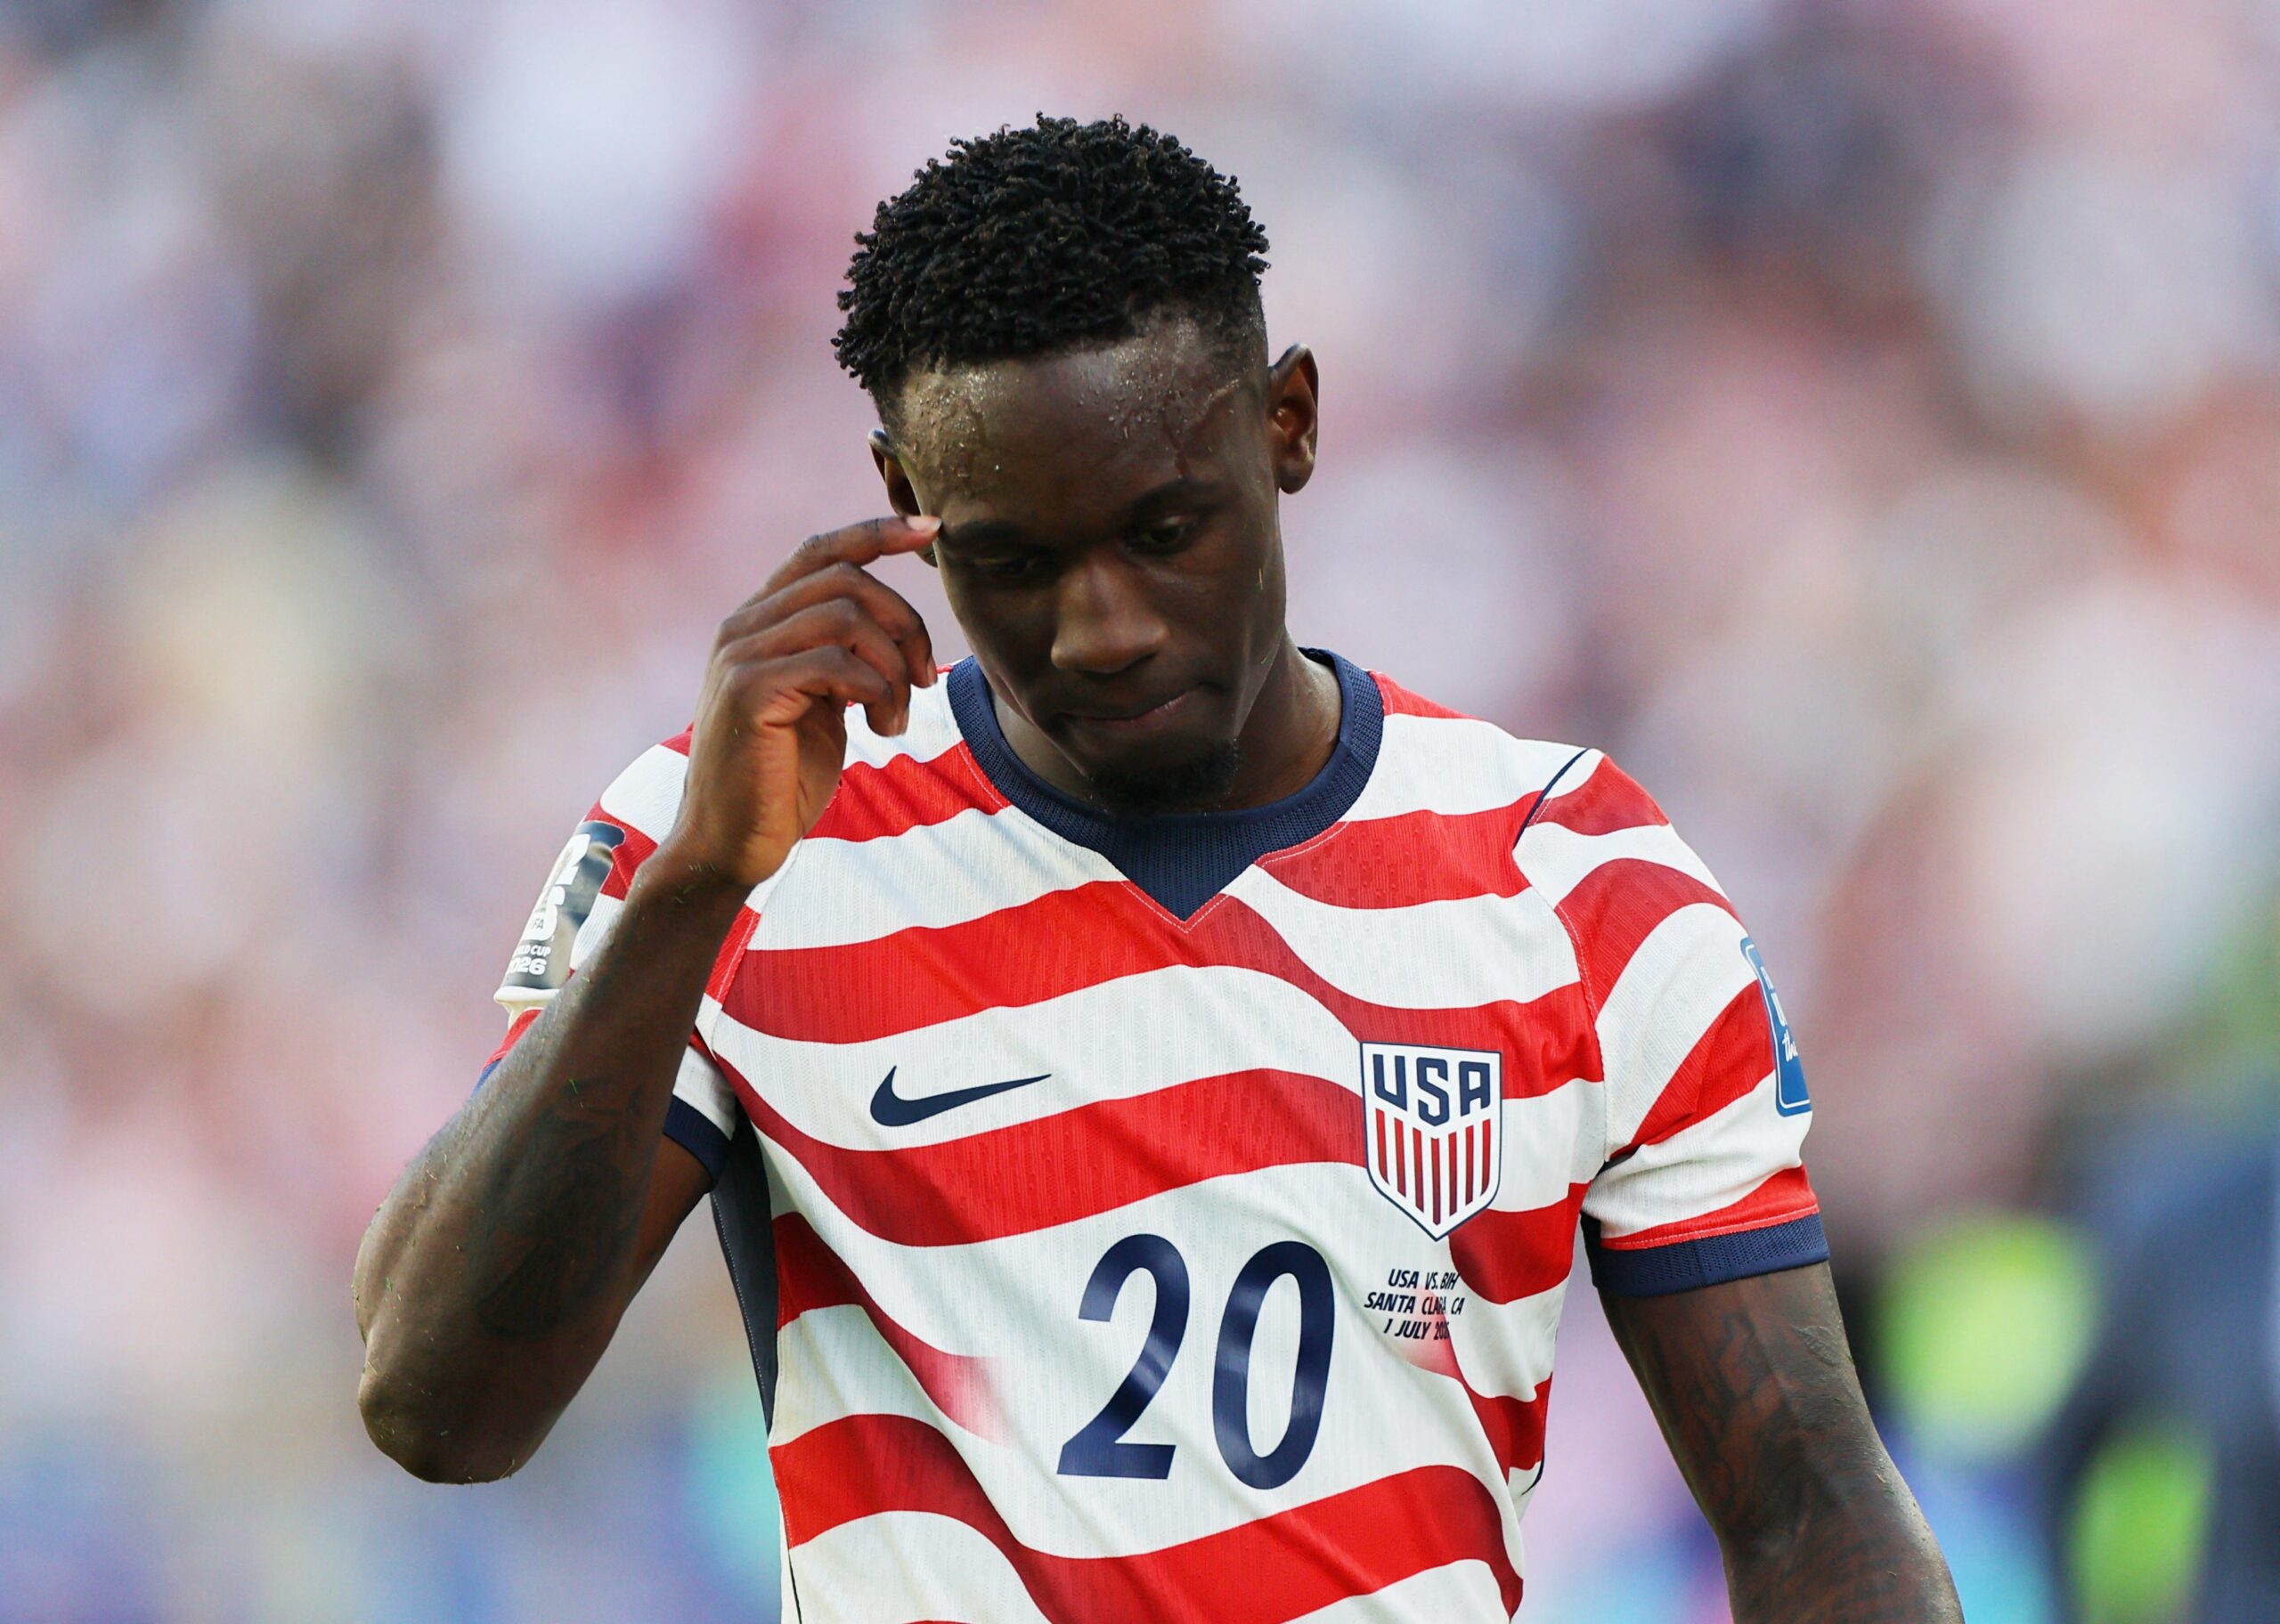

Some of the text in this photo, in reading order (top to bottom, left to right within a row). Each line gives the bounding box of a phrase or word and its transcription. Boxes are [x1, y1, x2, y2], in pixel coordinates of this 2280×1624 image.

[530, 945, 551, 957] CUP
[505, 956, 548, 976] 026
[1372, 1053, 1491, 1126] USA
[1388, 1269, 1461, 1290] USA VS. BIH
[1364, 1292, 1417, 1314] SANTA
[1383, 1319, 1394, 1334] 1
[1395, 1320, 1432, 1340] JULY
[1056, 1233, 1335, 1490] 20
